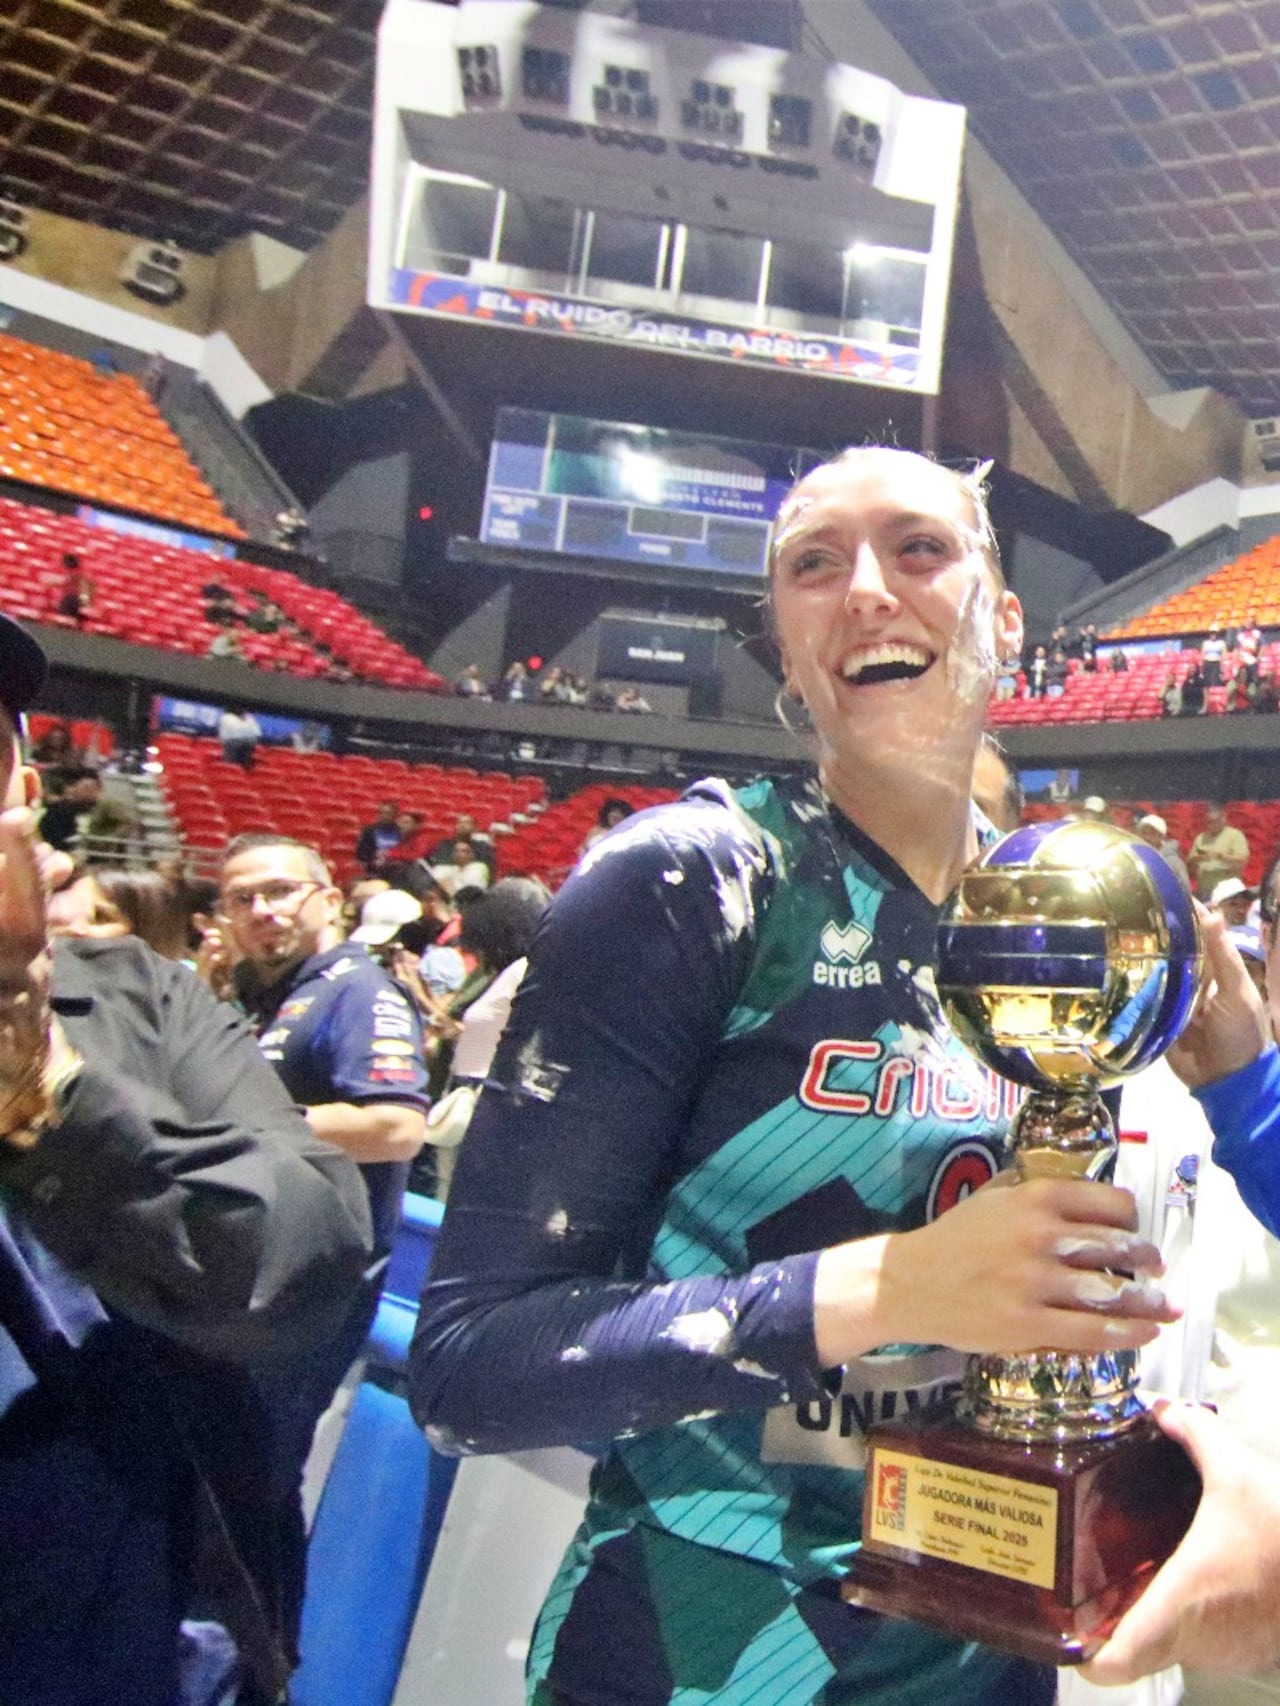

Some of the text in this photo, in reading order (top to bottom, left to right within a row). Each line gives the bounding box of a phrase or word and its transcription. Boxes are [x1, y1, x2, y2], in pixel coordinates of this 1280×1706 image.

[477, 291, 828, 359] EL RUIDO DEL BARRIO
[813, 961, 882, 988] errea
[917, 1483, 1044, 1529] JUGADORA MÁS VALIOSA
[933, 1509, 1028, 1548] SERIE FINAL 2025
